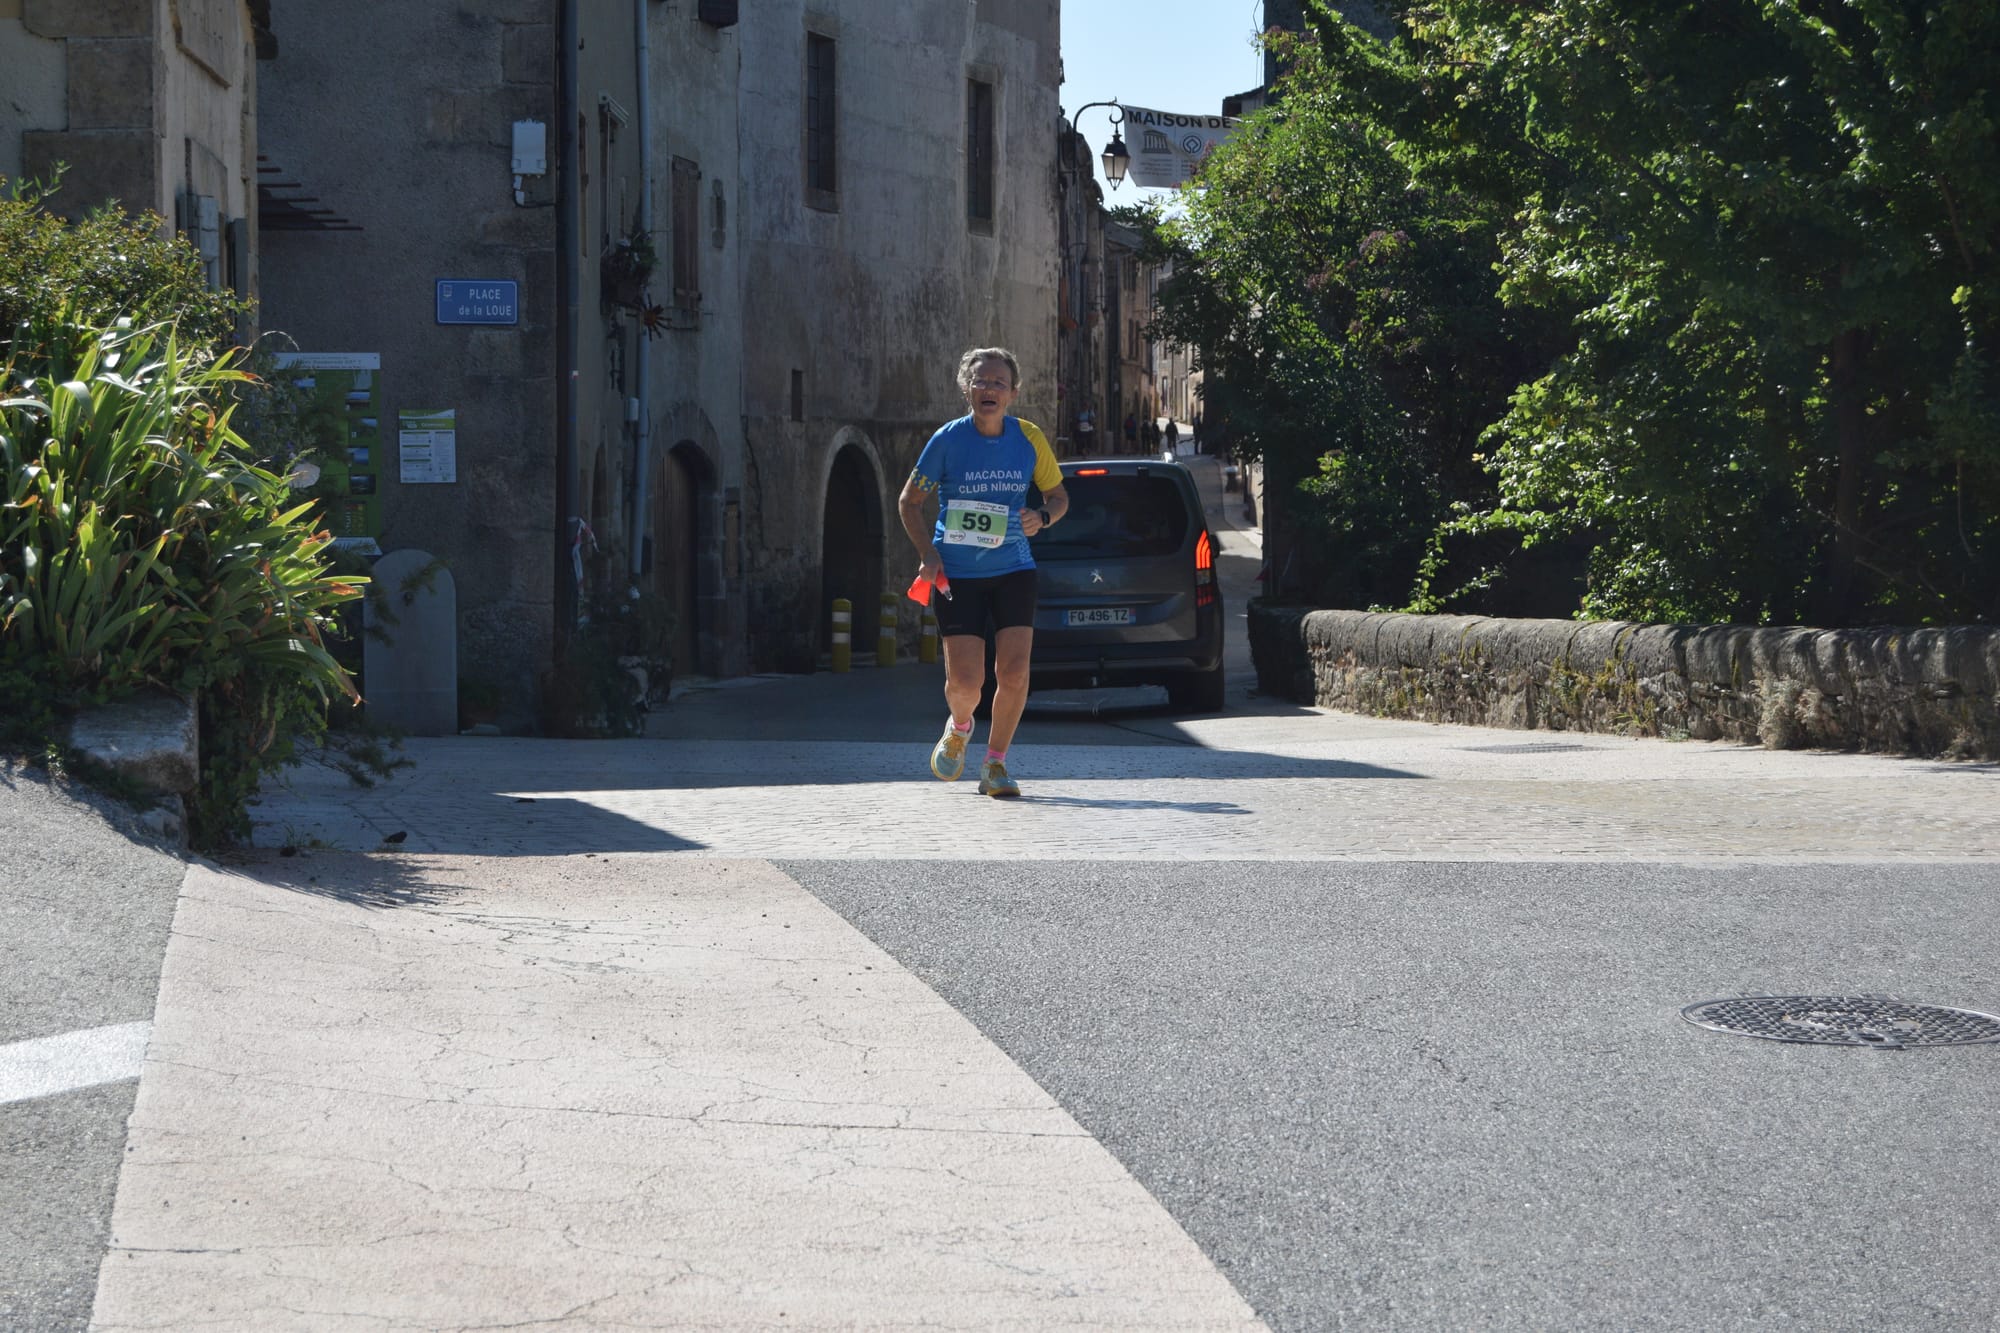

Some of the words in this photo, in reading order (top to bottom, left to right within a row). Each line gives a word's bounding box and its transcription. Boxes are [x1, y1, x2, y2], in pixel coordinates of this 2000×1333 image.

[1127, 110, 1202, 128] MAISON
[1207, 118, 1232, 128] DE
[469, 288, 501, 300] PLACE
[458, 304, 470, 316] de
[473, 304, 482, 316] la
[486, 304, 512, 316] LOUE
[965, 470, 1023, 481] MACADAM
[958, 484, 988, 494] CLUB
[962, 512, 992, 532] 59
